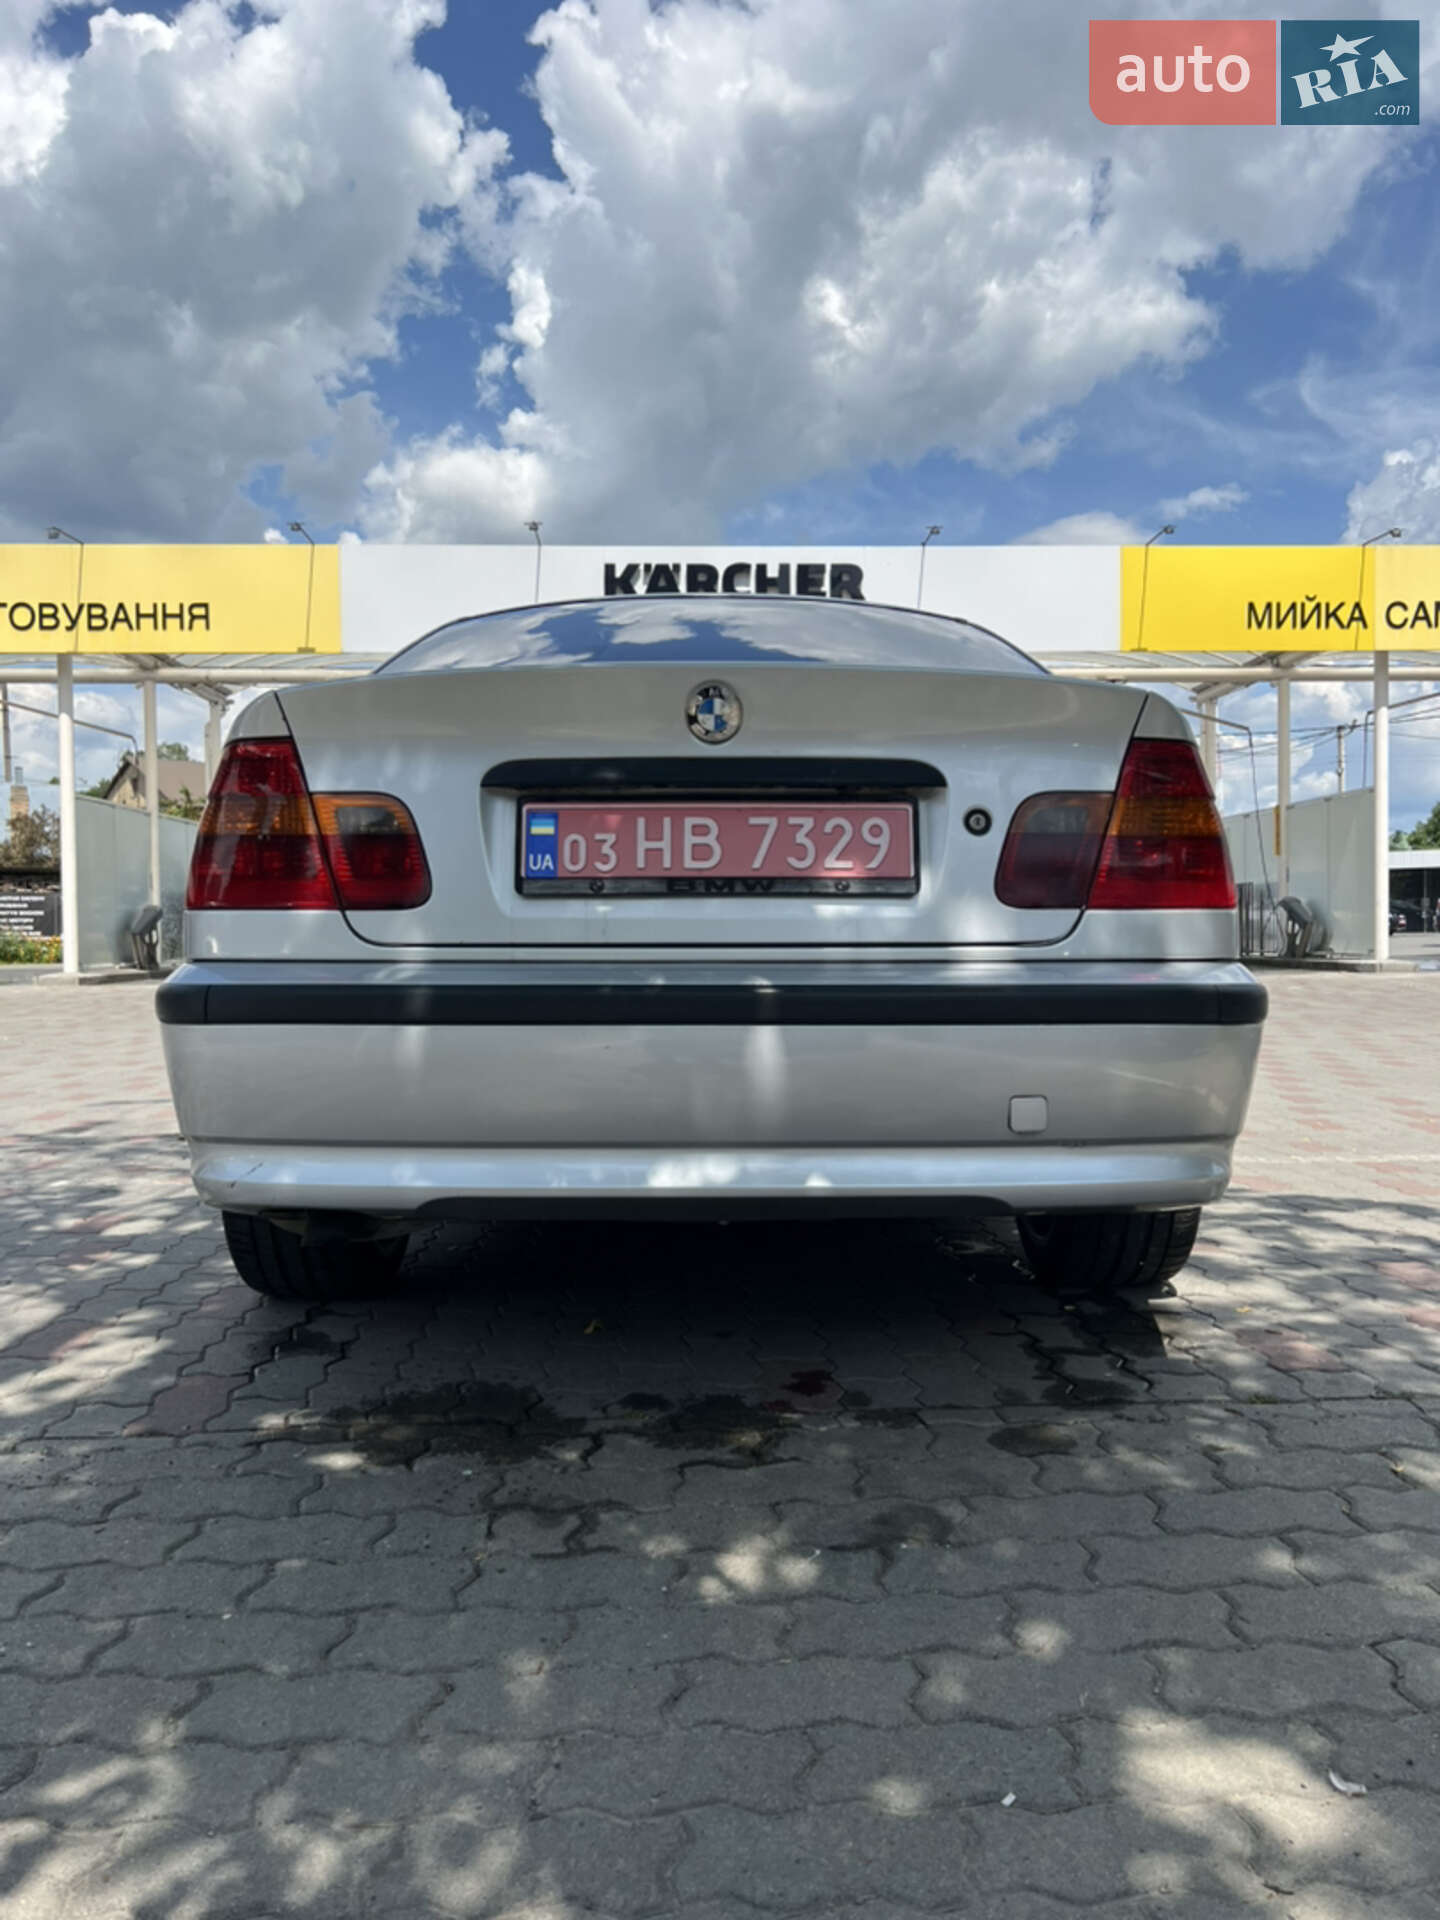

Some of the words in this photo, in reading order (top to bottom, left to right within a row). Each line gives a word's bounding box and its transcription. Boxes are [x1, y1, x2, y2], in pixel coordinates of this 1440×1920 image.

[604, 563, 865, 600] KÄRCHER
[0, 602, 210, 631] ОВУВАННЯ
[1247, 595, 1369, 630] МИЙКА
[563, 833, 618, 872] 03
[635, 816, 722, 869] HB
[747, 816, 891, 869] 7329
[527, 854, 554, 871] UA
